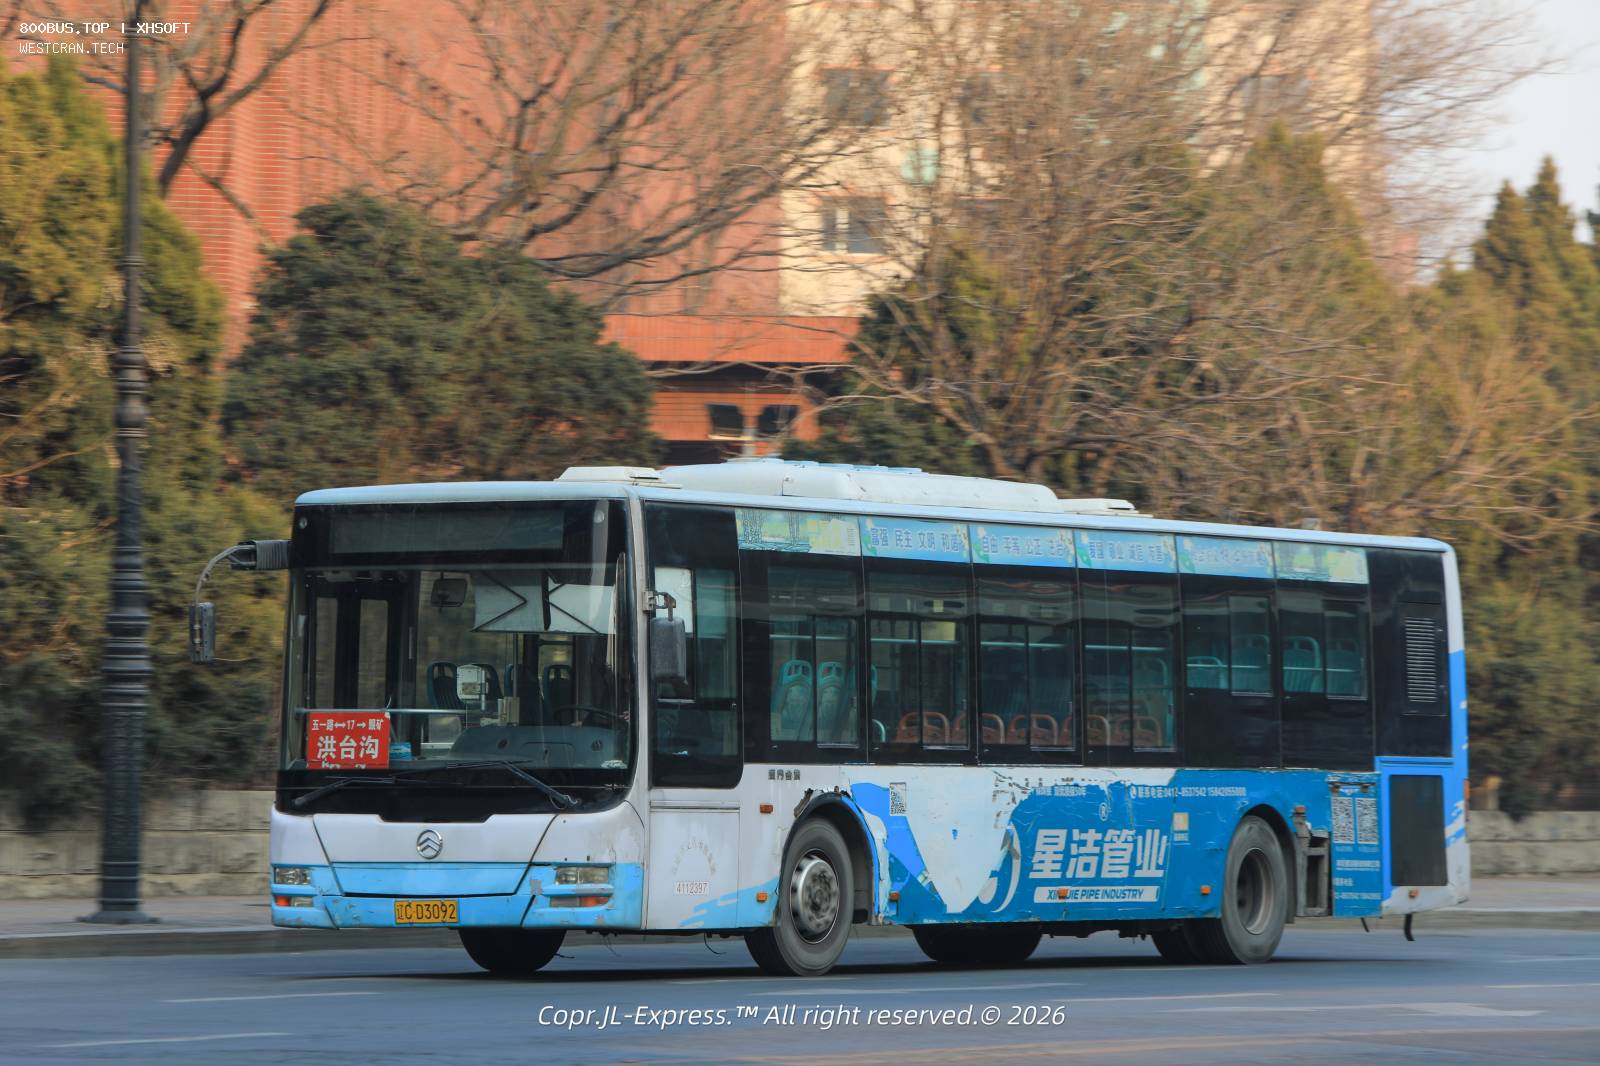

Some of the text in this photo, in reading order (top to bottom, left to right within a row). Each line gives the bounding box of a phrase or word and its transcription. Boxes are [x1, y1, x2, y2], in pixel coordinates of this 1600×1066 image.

[346, 719, 355, 730] 17
[316, 735, 380, 760] 洪台沟
[1028, 828, 1168, 879] 星洁管业
[1080, 889, 1100, 899] PIPE
[1101, 889, 1144, 899] INDUSTRY
